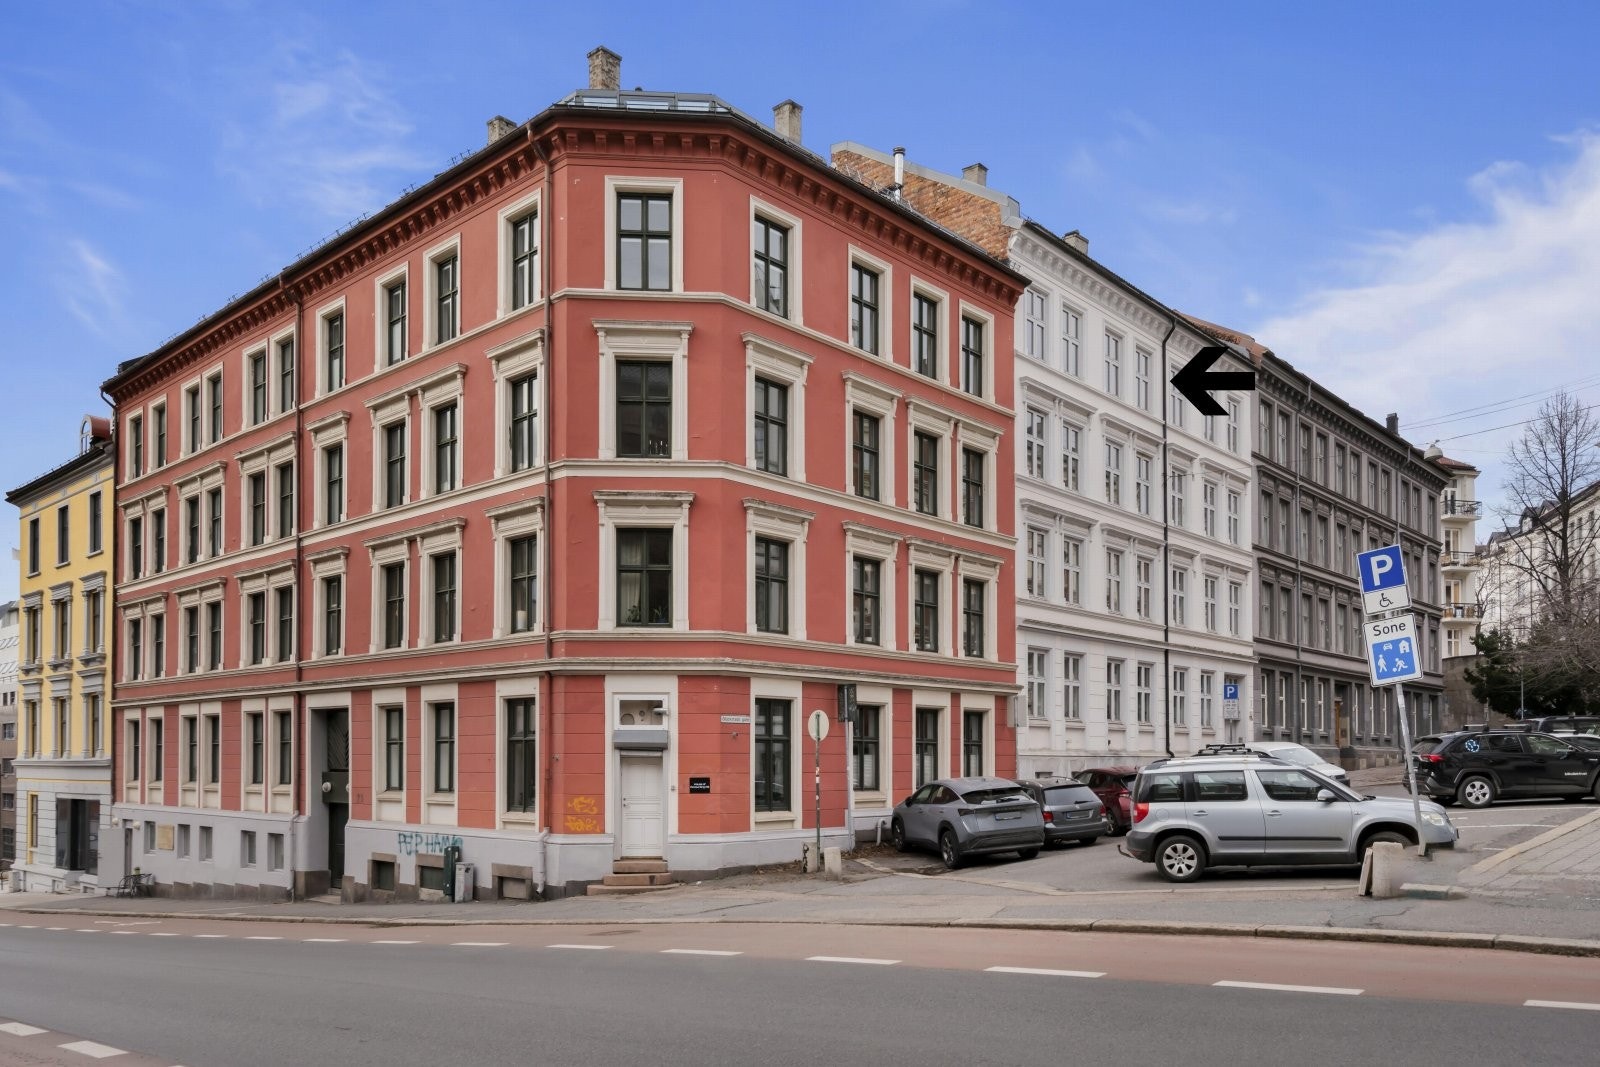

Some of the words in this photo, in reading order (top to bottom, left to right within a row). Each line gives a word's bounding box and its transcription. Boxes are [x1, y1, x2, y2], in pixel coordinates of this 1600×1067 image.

[1370, 554, 1393, 586] P
[1372, 622, 1406, 637] Sone
[1226, 686, 1235, 698] P
